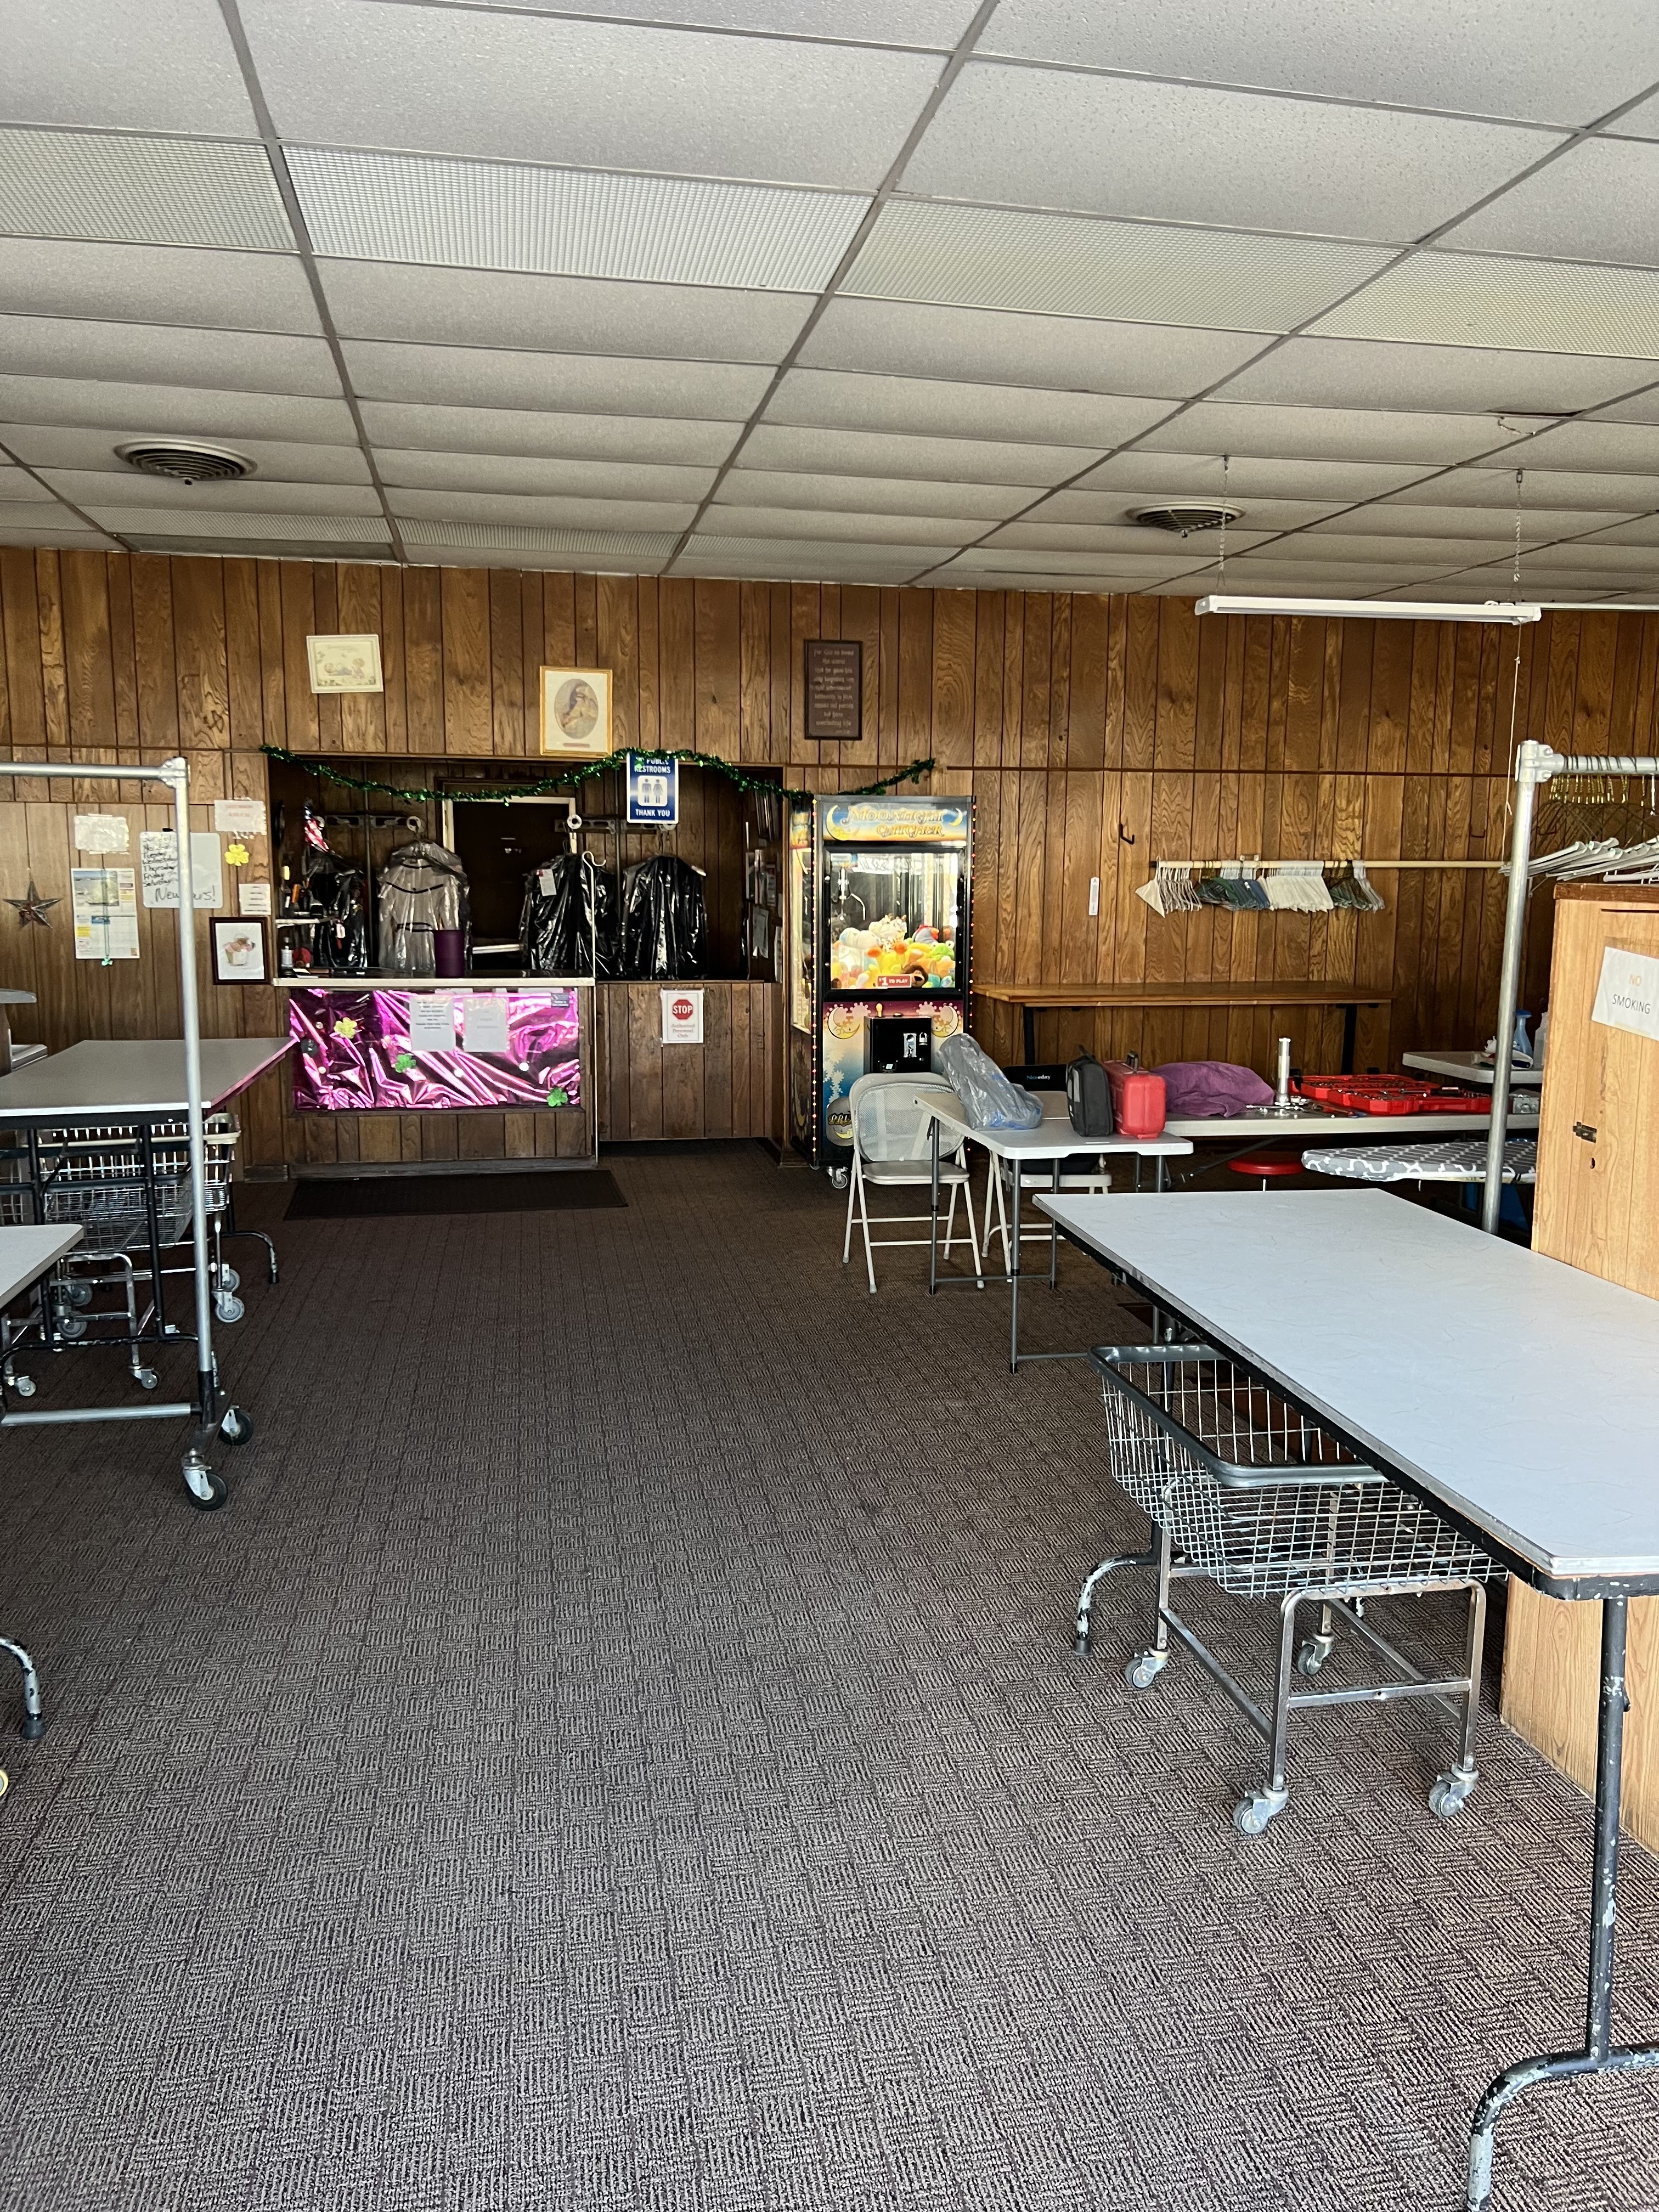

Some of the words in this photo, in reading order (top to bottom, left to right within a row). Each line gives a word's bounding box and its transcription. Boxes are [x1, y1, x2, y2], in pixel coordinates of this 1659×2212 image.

[1628, 974, 1642, 986] NO
[673, 1005, 692, 1014] STOP
[1612, 994, 1651, 1014] SMOKING
